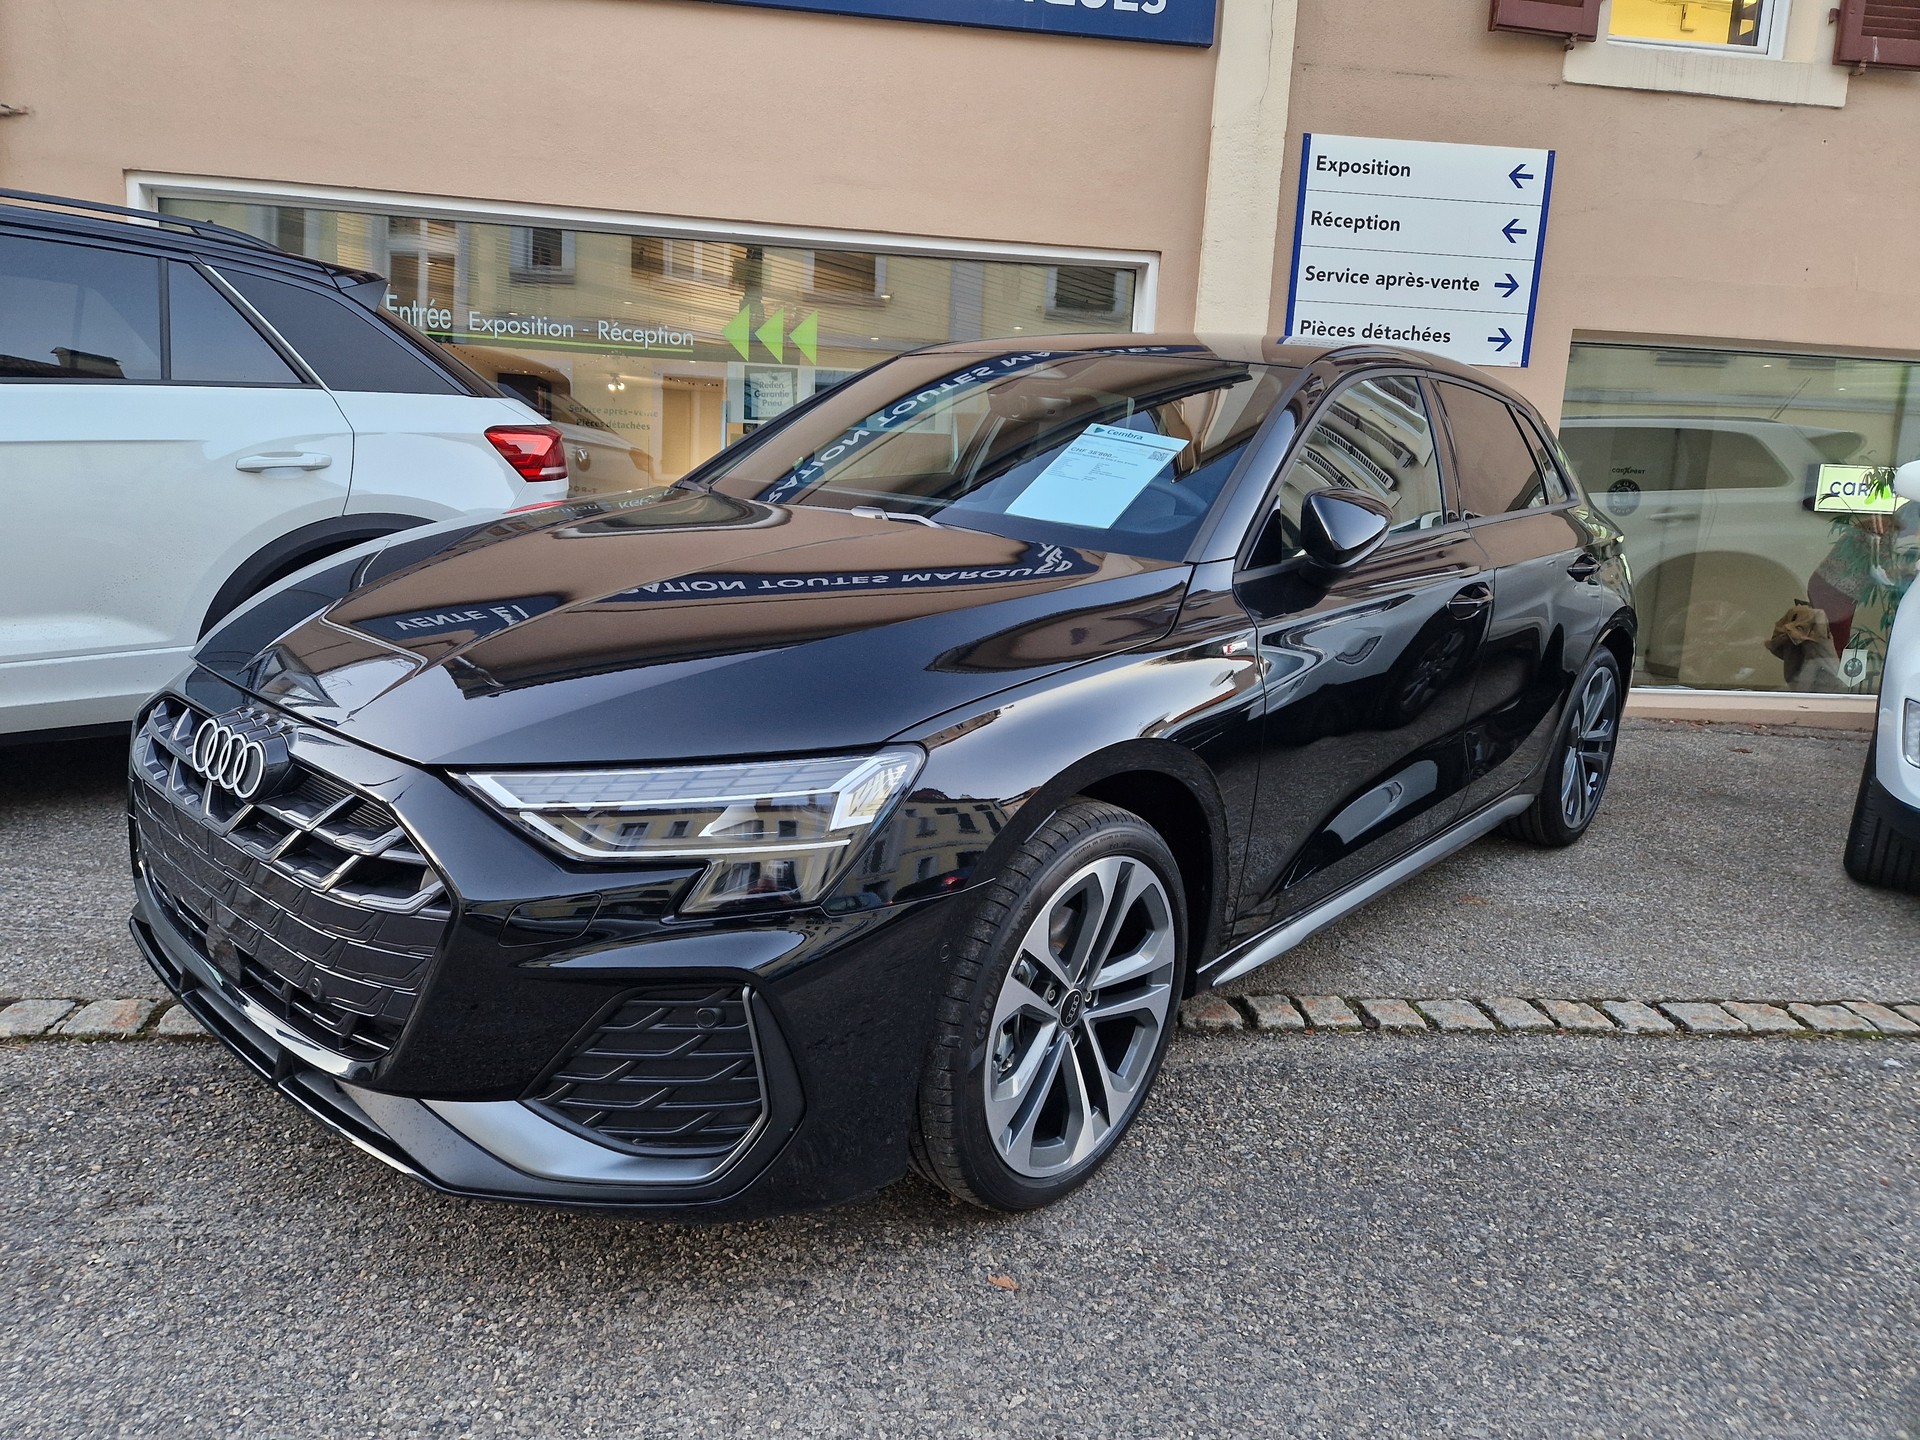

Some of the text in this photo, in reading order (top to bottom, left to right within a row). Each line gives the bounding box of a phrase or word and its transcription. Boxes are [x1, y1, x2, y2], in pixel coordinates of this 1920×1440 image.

[1315, 155, 1411, 178] Exposition
[1310, 210, 1401, 233] Réception
[1304, 265, 1480, 291] Service après-vente
[386, 294, 452, 329] Entrée
[468, 311, 574, 338] Exposition
[598, 320, 694, 350] Réception
[1300, 319, 1451, 343] Pièces détachées
[759, 380, 785, 390] Reifen
[754, 390, 790, 398] Garantie
[569, 404, 602, 414] Service
[576, 417, 651, 430] Pièces détachées
[1107, 429, 1144, 440] Cembra
[1070, 447, 1087, 455] CHF
